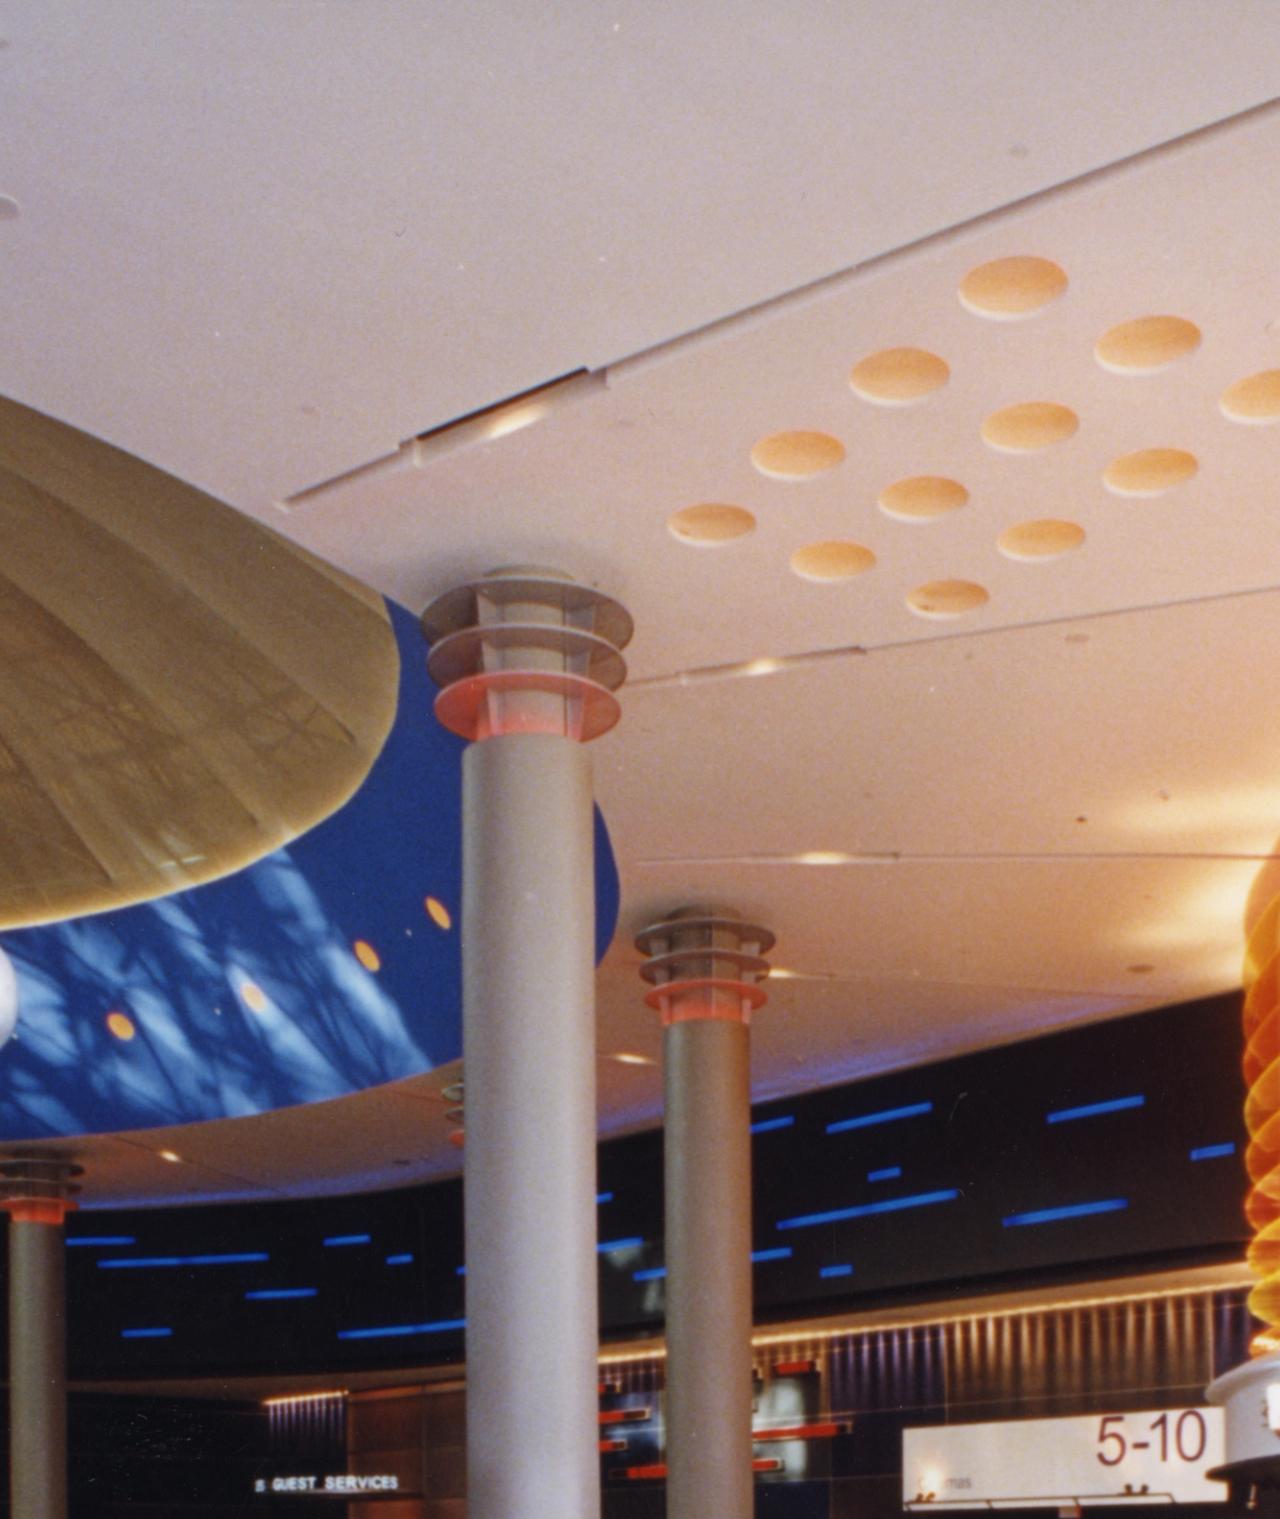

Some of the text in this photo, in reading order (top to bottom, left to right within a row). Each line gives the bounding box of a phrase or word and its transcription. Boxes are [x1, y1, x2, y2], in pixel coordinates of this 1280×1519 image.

[1097, 1410, 1207, 1466] 5-10
[272, 1476, 317, 1491] GUEST
[324, 1475, 398, 1491] SERVICES
